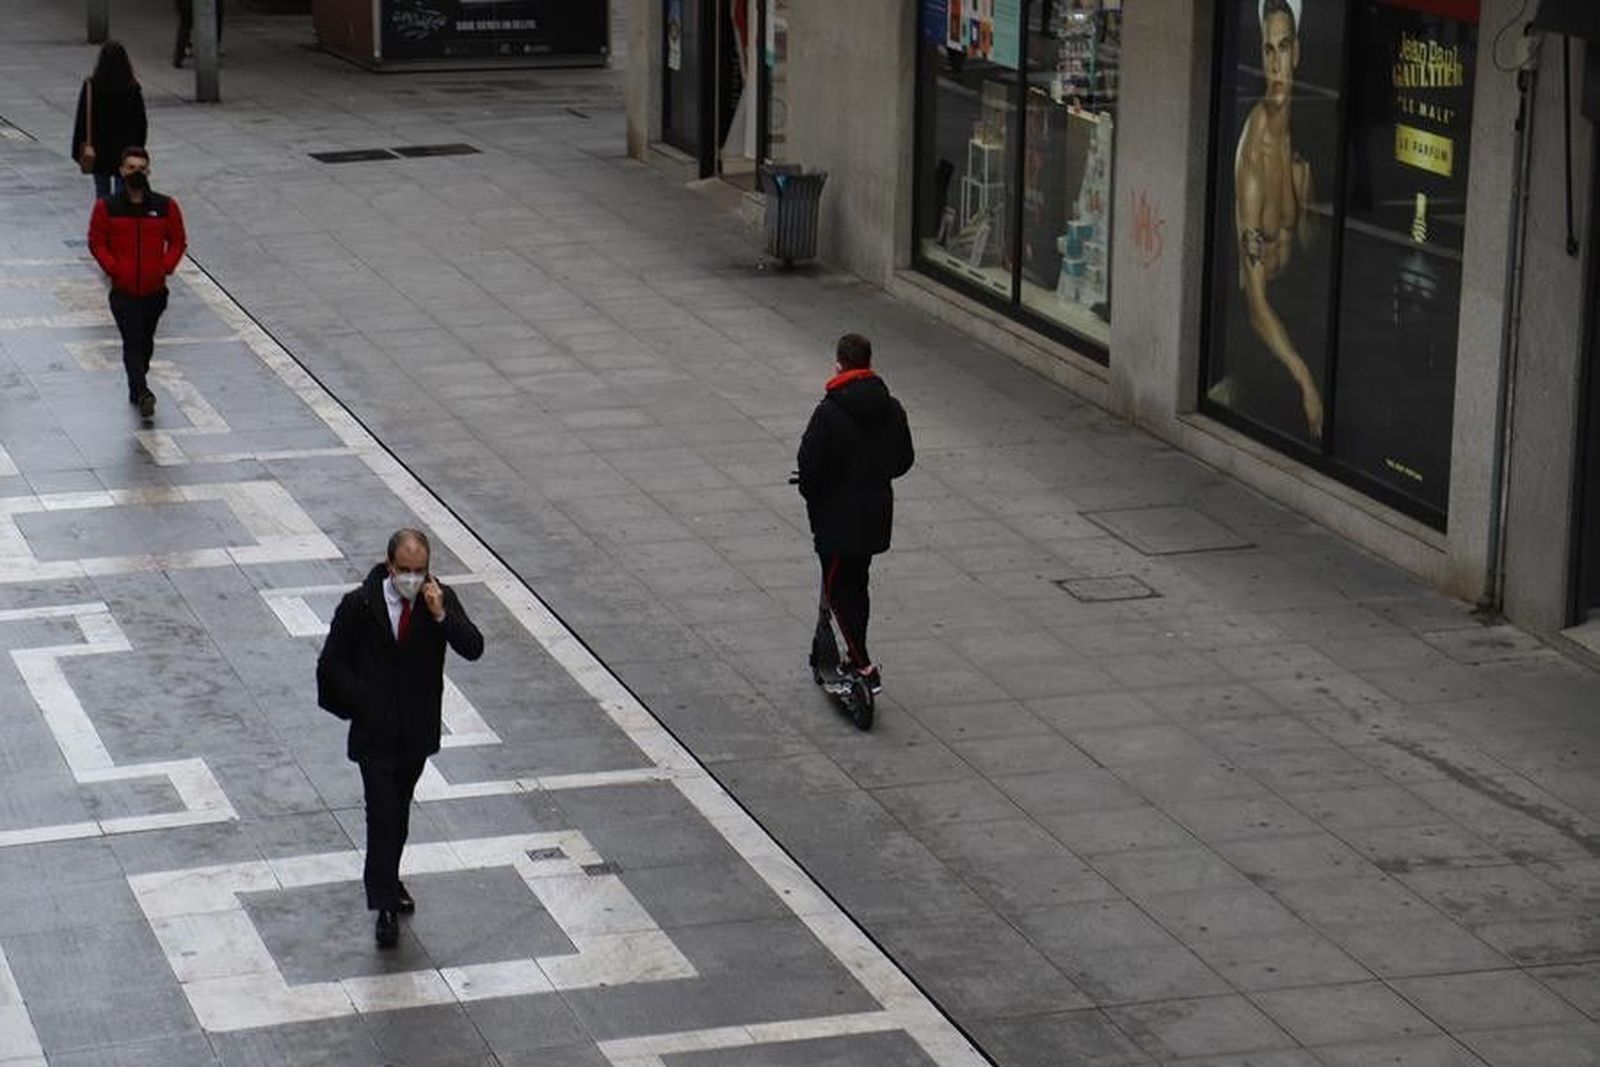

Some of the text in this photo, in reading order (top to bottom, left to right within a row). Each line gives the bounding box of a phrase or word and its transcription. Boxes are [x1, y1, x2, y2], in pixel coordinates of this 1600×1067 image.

[1399, 30, 1459, 66] Jean Paul
[1393, 62, 1464, 87] GAULTIER
[1412, 140, 1449, 163] PARFUM
